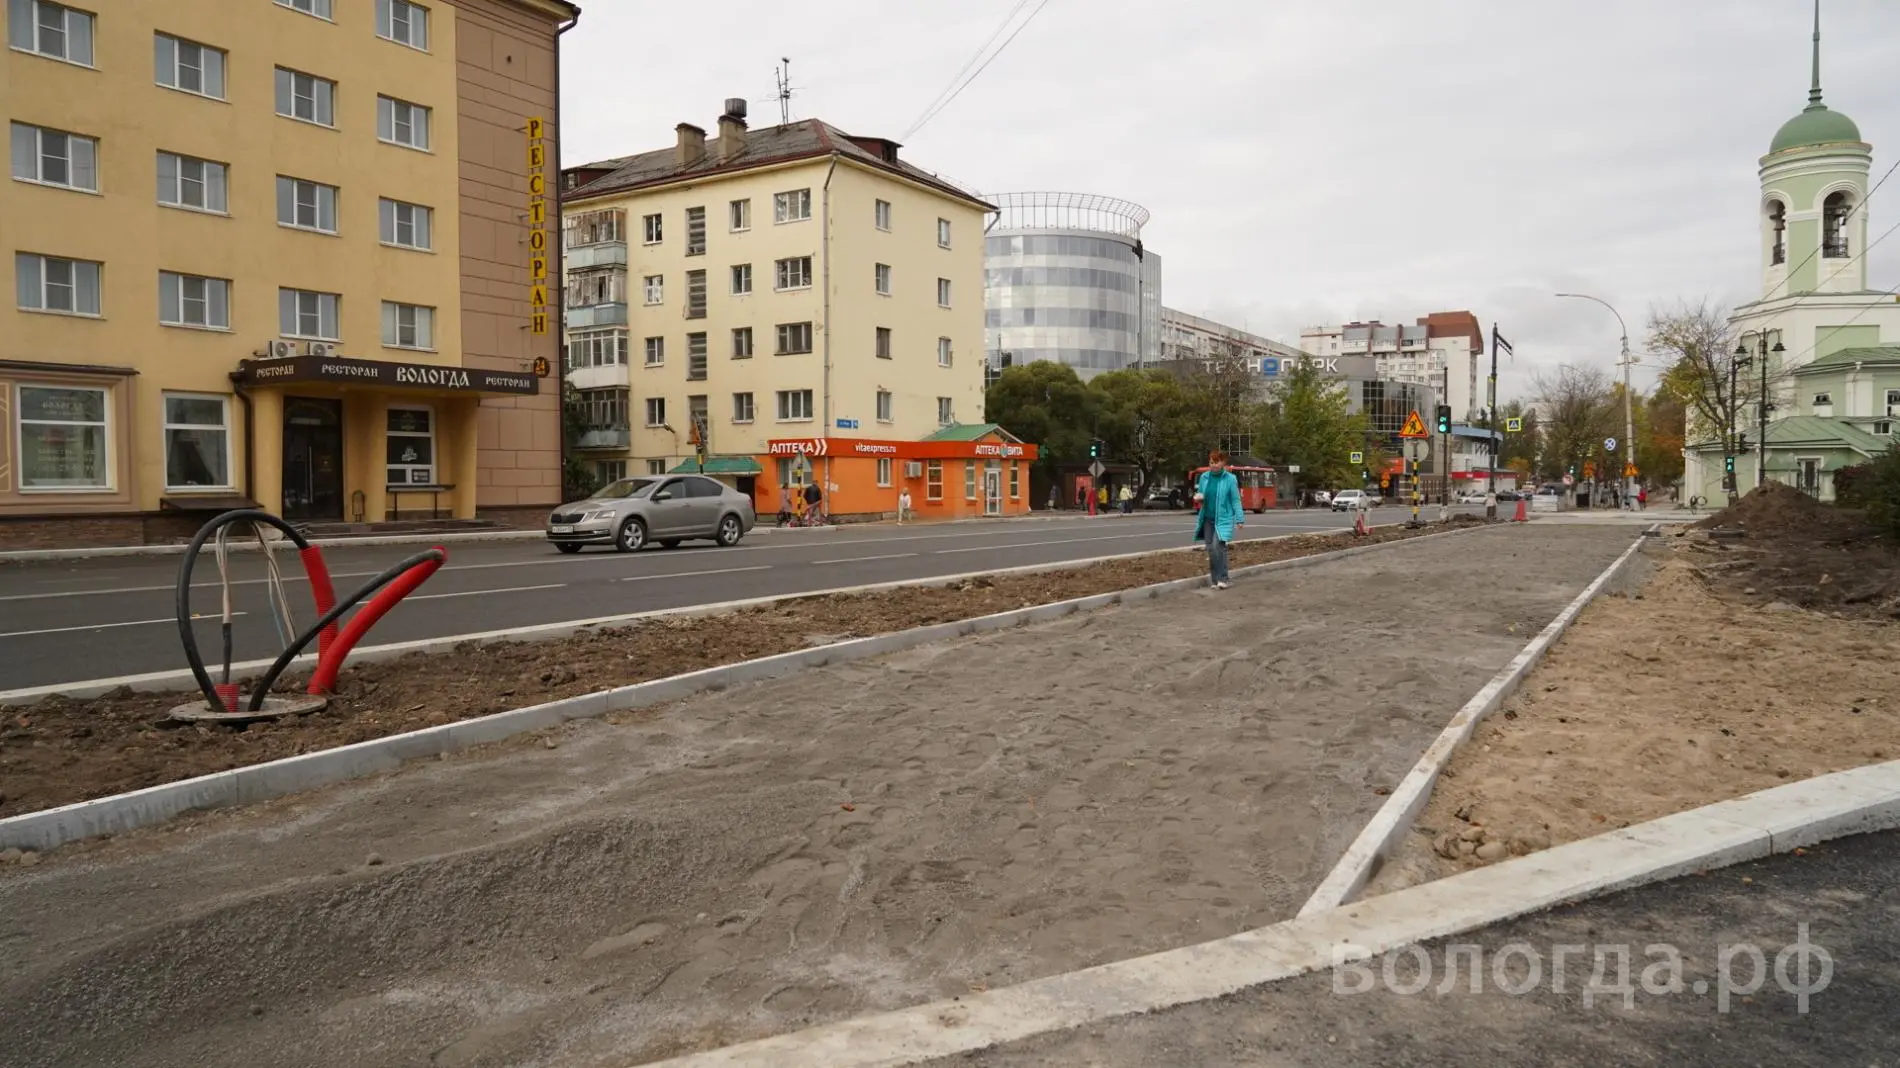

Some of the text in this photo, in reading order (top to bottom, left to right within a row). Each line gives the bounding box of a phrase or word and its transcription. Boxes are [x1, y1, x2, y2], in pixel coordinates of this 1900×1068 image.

[528, 118, 547, 334] РЕСТОРАН
[256, 364, 295, 378] РЕСТОРАН
[321, 363, 531, 389] РЕСТОРАН ВОЛОГДА РЕСТОРАН
[770, 442, 815, 454] АПТЕКА
[855, 442, 897, 455] vitaexpress.ru
[975, 444, 1001, 456] АПТЕКА
